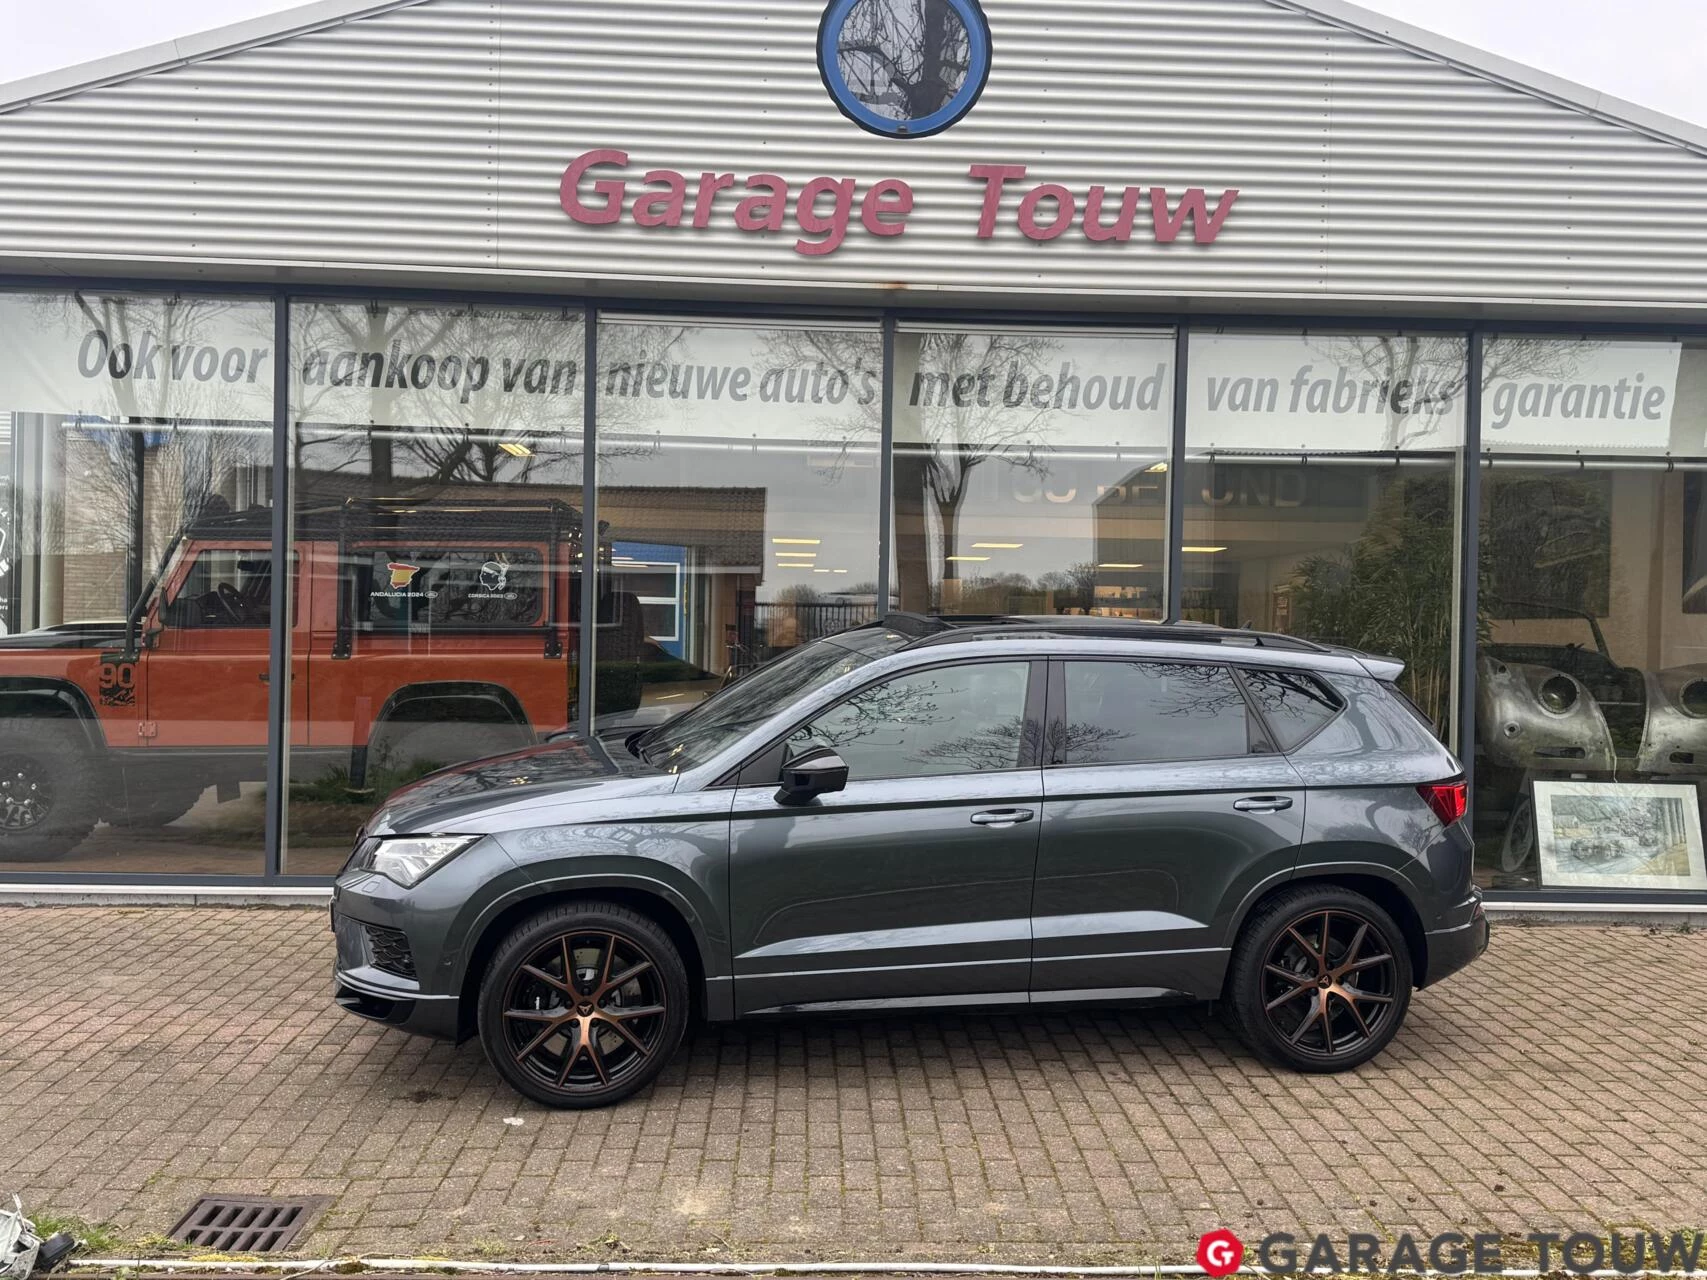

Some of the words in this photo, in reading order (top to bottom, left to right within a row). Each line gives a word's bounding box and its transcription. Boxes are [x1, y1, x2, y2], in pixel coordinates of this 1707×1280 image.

[559, 148, 914, 257] Garage
[968, 164, 1240, 244] Touw
[77, 329, 157, 381] Ook
[169, 340, 268, 385] voor
[302, 340, 489, 404] aankoop
[503, 354, 577, 396] van
[604, 350, 749, 402] nieuwe
[760, 357, 877, 405] auto's
[909, 364, 993, 410] met
[1003, 362, 1167, 411] behoud
[1207, 375, 1279, 414] van
[1289, 364, 1457, 417] fabrieks
[1492, 372, 1666, 430] garantie
[100, 662, 135, 688] 90
